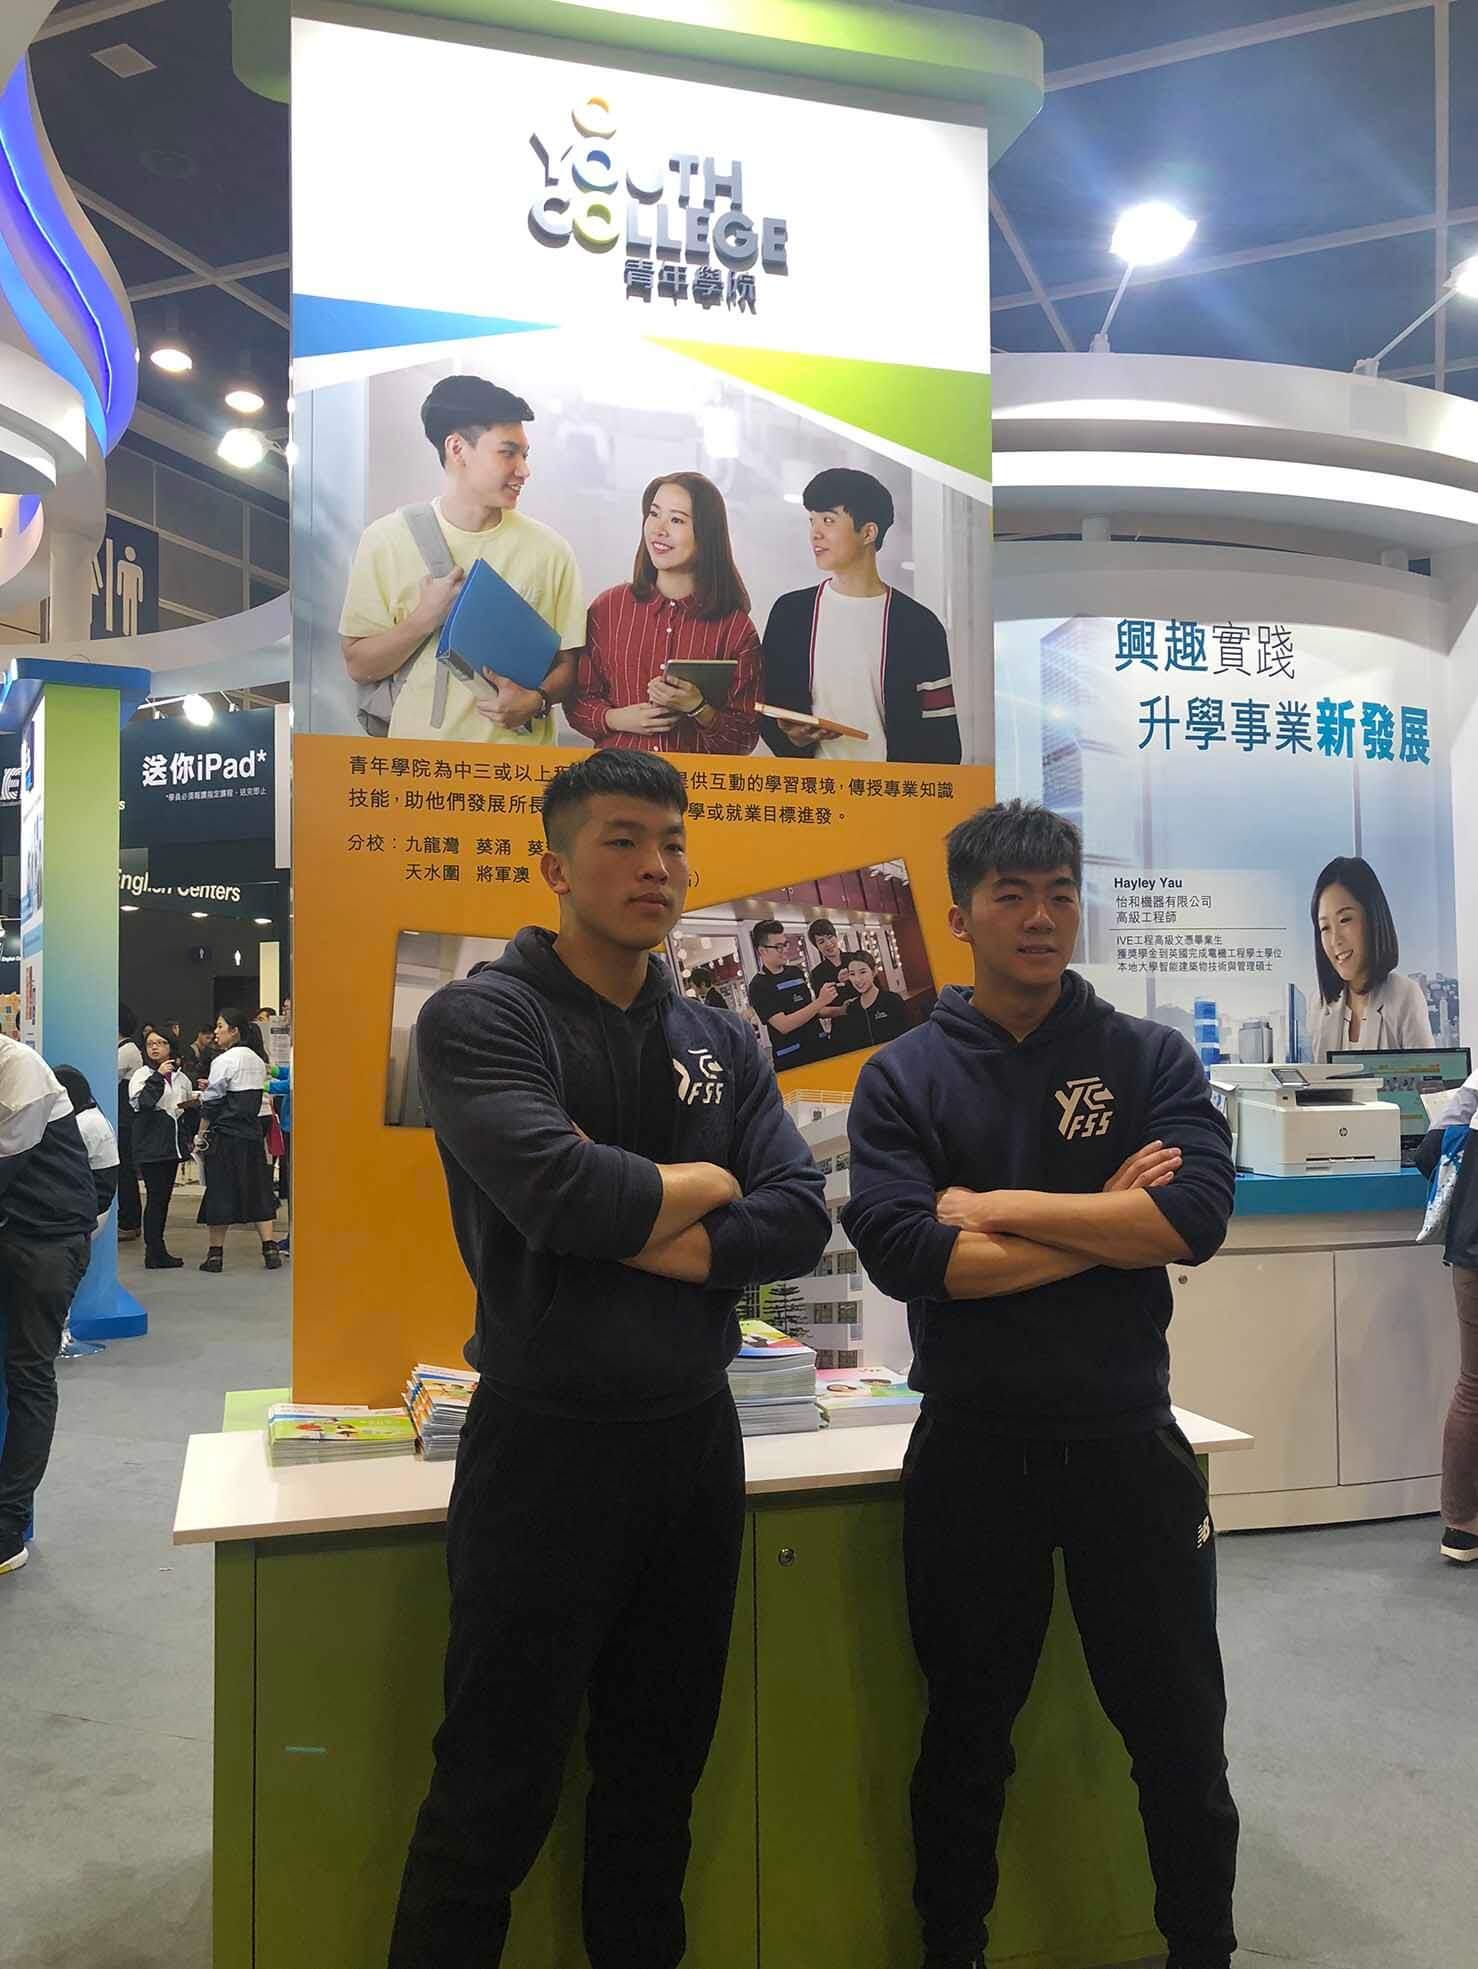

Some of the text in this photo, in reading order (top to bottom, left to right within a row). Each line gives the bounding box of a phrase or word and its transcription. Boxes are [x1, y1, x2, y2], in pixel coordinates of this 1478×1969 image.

[528, 132, 744, 212] YOUTH
[527, 197, 788, 276] COLLEGE
[624, 259, 757, 315] 青年學院
[1115, 619, 1295, 679] 興趣實踐
[1138, 695, 1431, 765] 升學事業新發展
[406, 836, 459, 855] 九龍灣
[476, 838, 512, 856] 葵涌
[476, 865, 530, 883] 將軍澳
[1114, 877, 1183, 891] Hayley Yau
[1116, 895, 1212, 908] 怡和機器有限公司
[1116, 911, 1177, 924] 高級工程師
